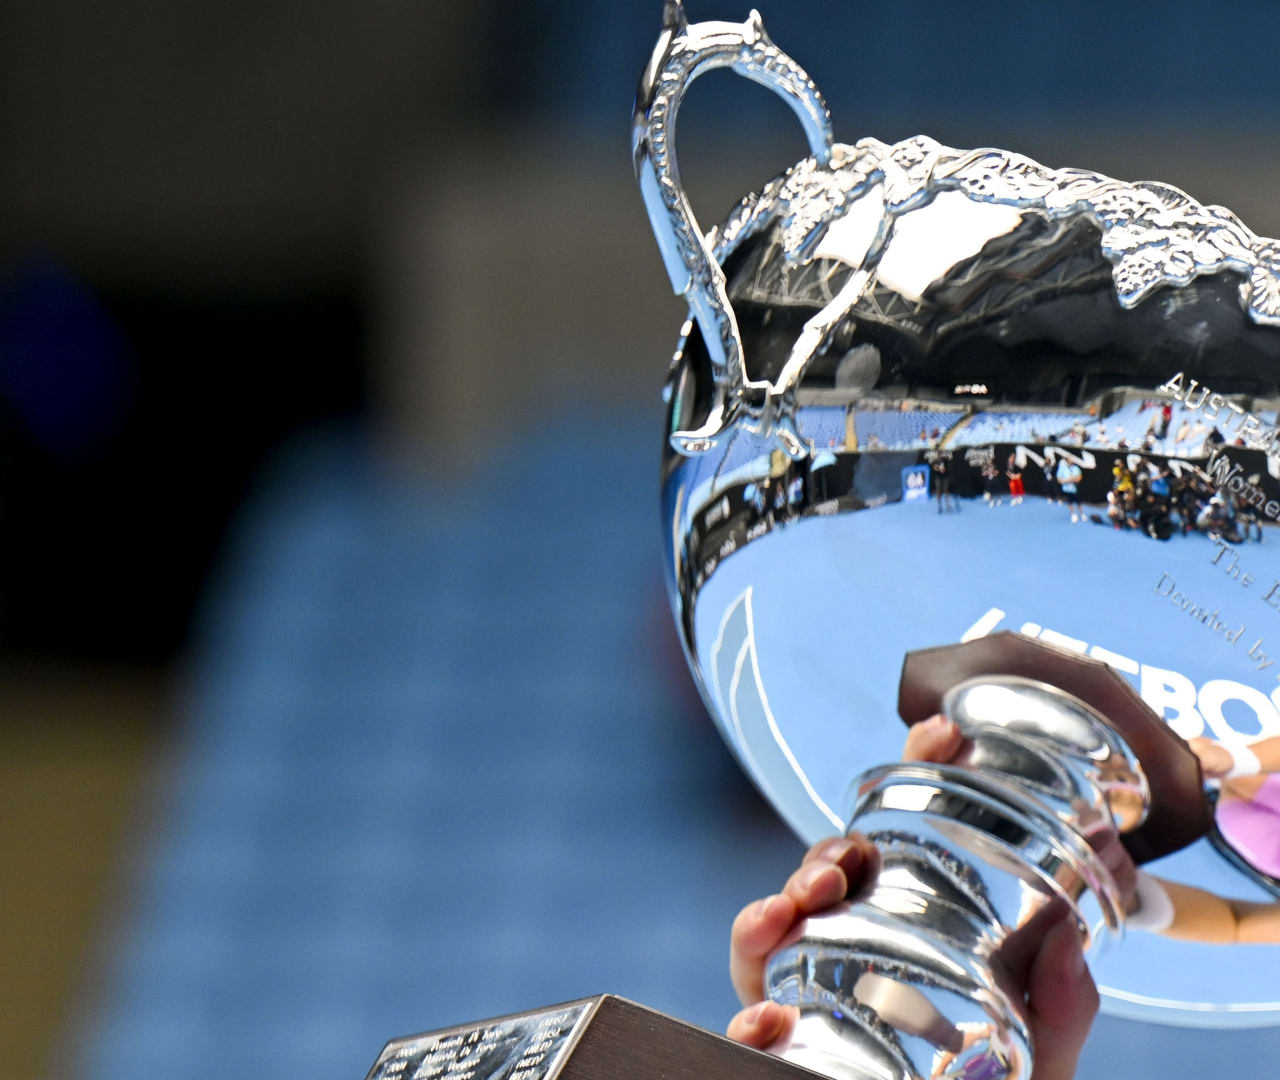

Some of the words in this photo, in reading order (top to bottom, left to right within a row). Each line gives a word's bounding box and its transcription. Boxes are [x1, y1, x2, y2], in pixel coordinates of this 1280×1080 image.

[1210, 538, 1256, 588] The
[1153, 571, 1246, 645] Donated
[1248, 638, 1276, 672] by
